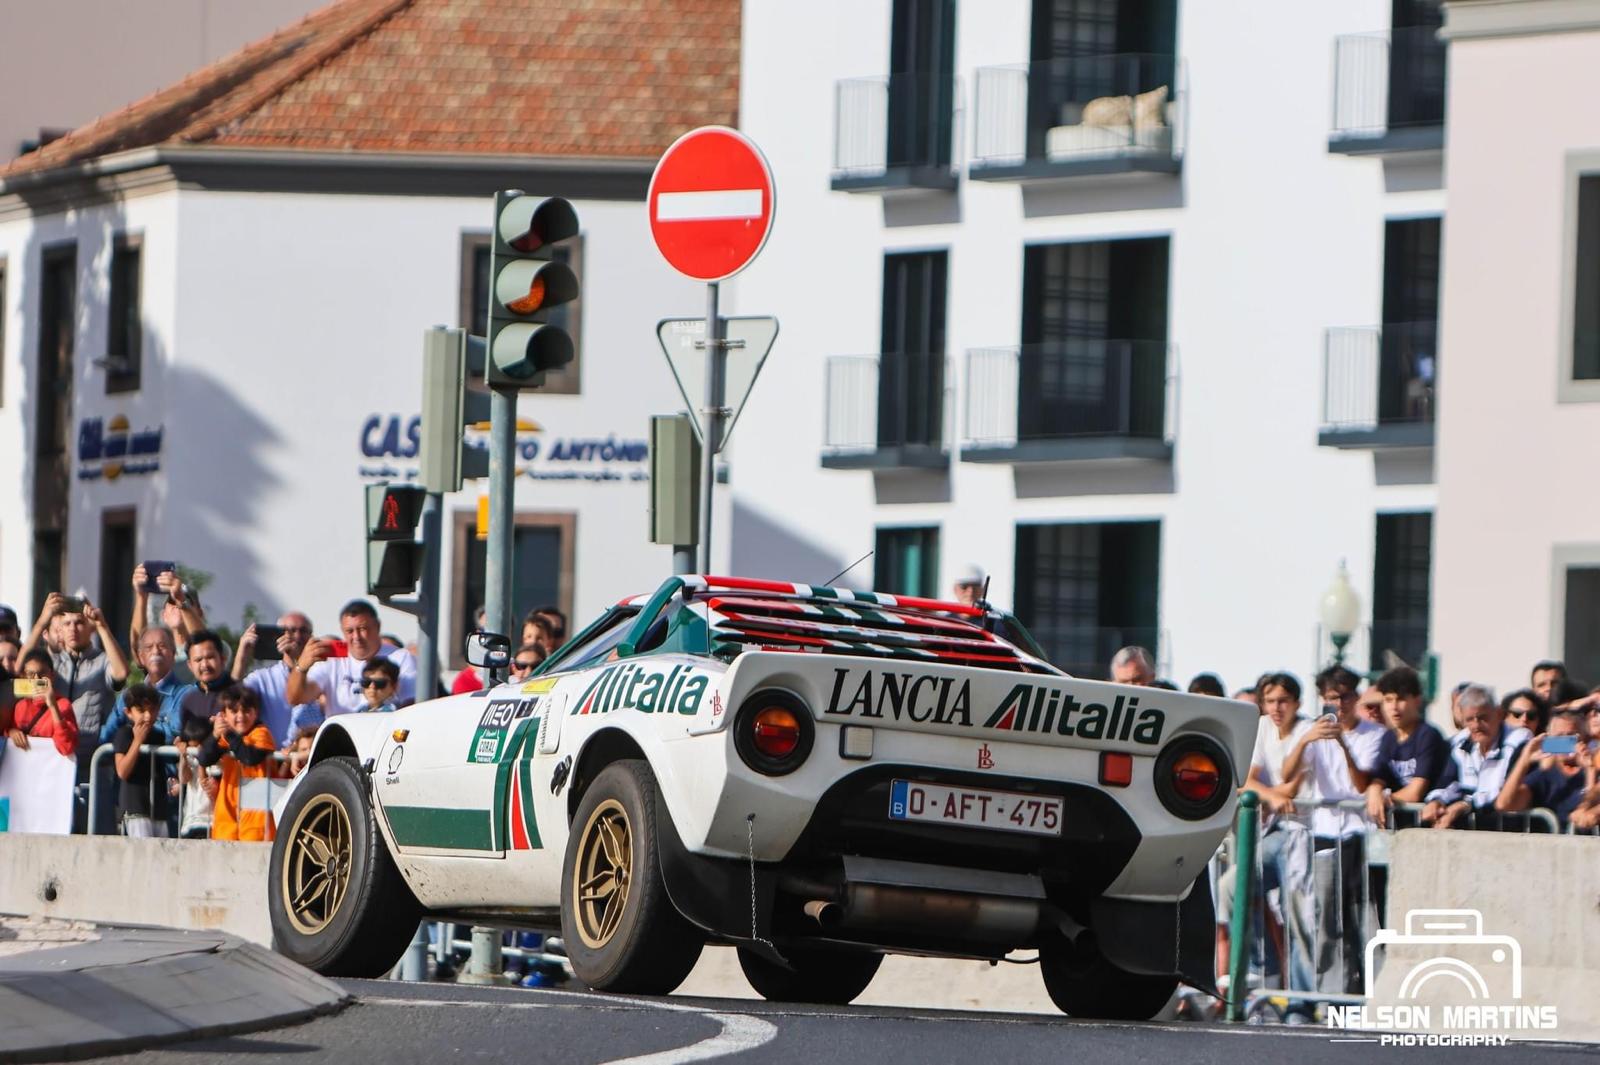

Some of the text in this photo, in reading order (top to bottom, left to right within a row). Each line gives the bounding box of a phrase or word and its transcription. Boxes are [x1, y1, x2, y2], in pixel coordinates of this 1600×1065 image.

[570, 664, 709, 715] Alitalia
[481, 702, 515, 727] MEO
[825, 668, 1166, 745] LANCIA Alitalia
[386, 777, 400, 785] Shell
[893, 802, 904, 815] B
